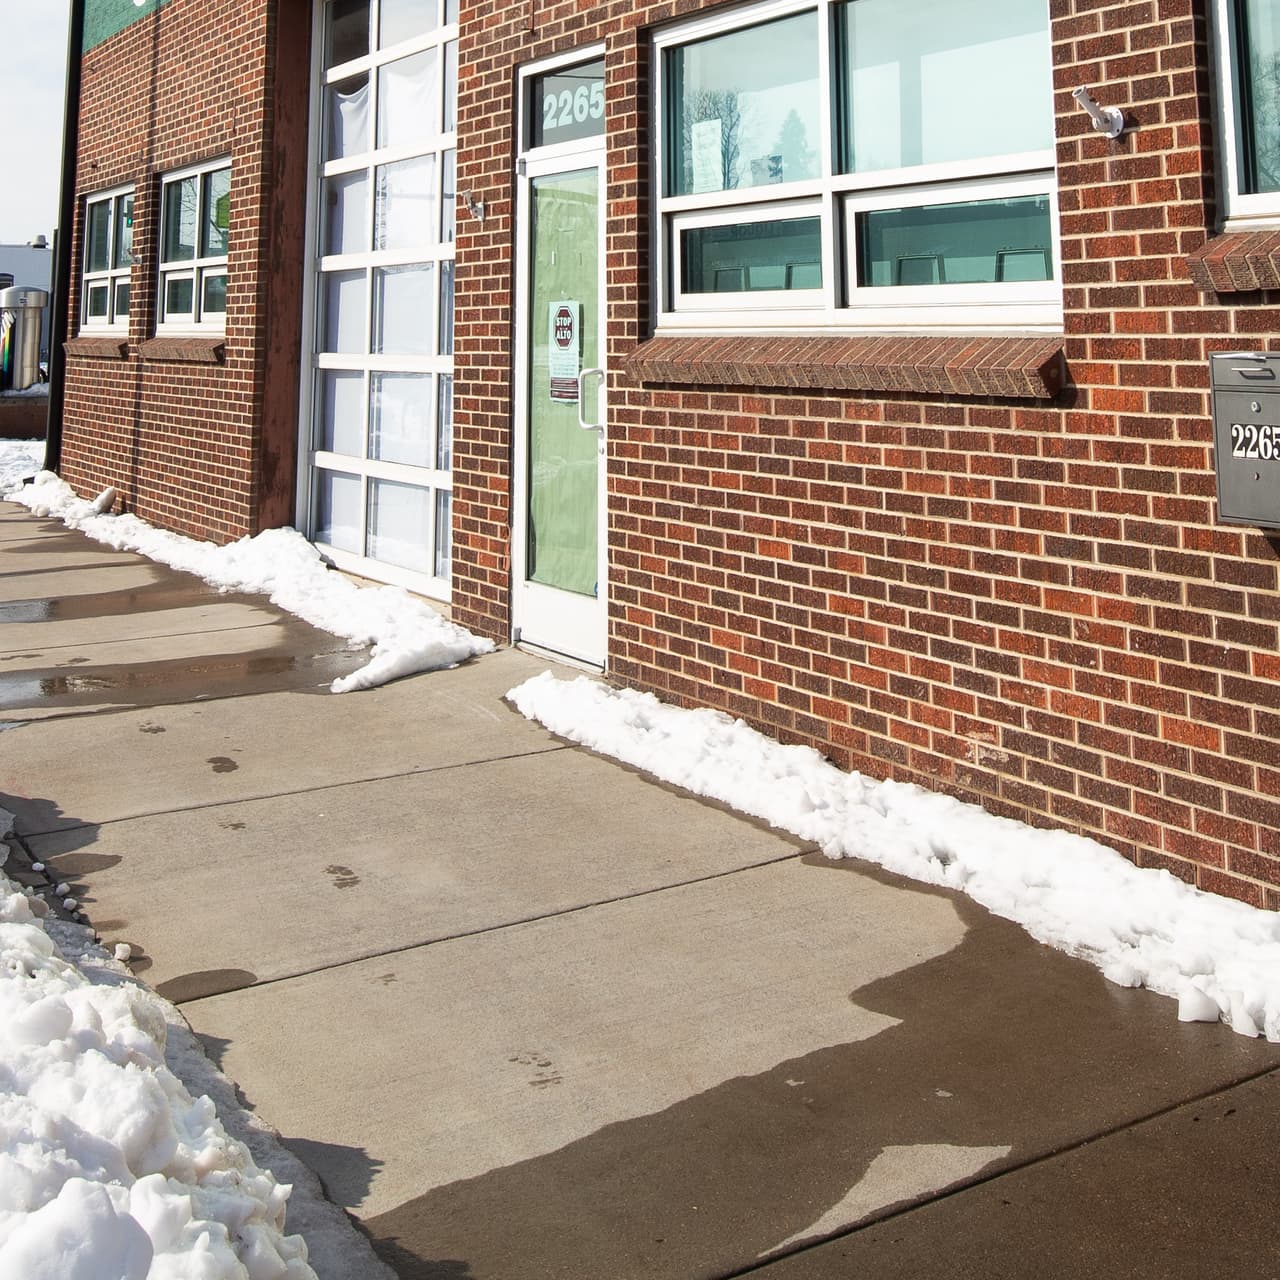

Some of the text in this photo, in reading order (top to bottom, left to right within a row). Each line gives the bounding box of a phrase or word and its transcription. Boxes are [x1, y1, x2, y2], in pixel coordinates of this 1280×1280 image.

[543, 81, 605, 130] 2265
[556, 317, 572, 327] STOP
[556, 330, 572, 339] ALTO
